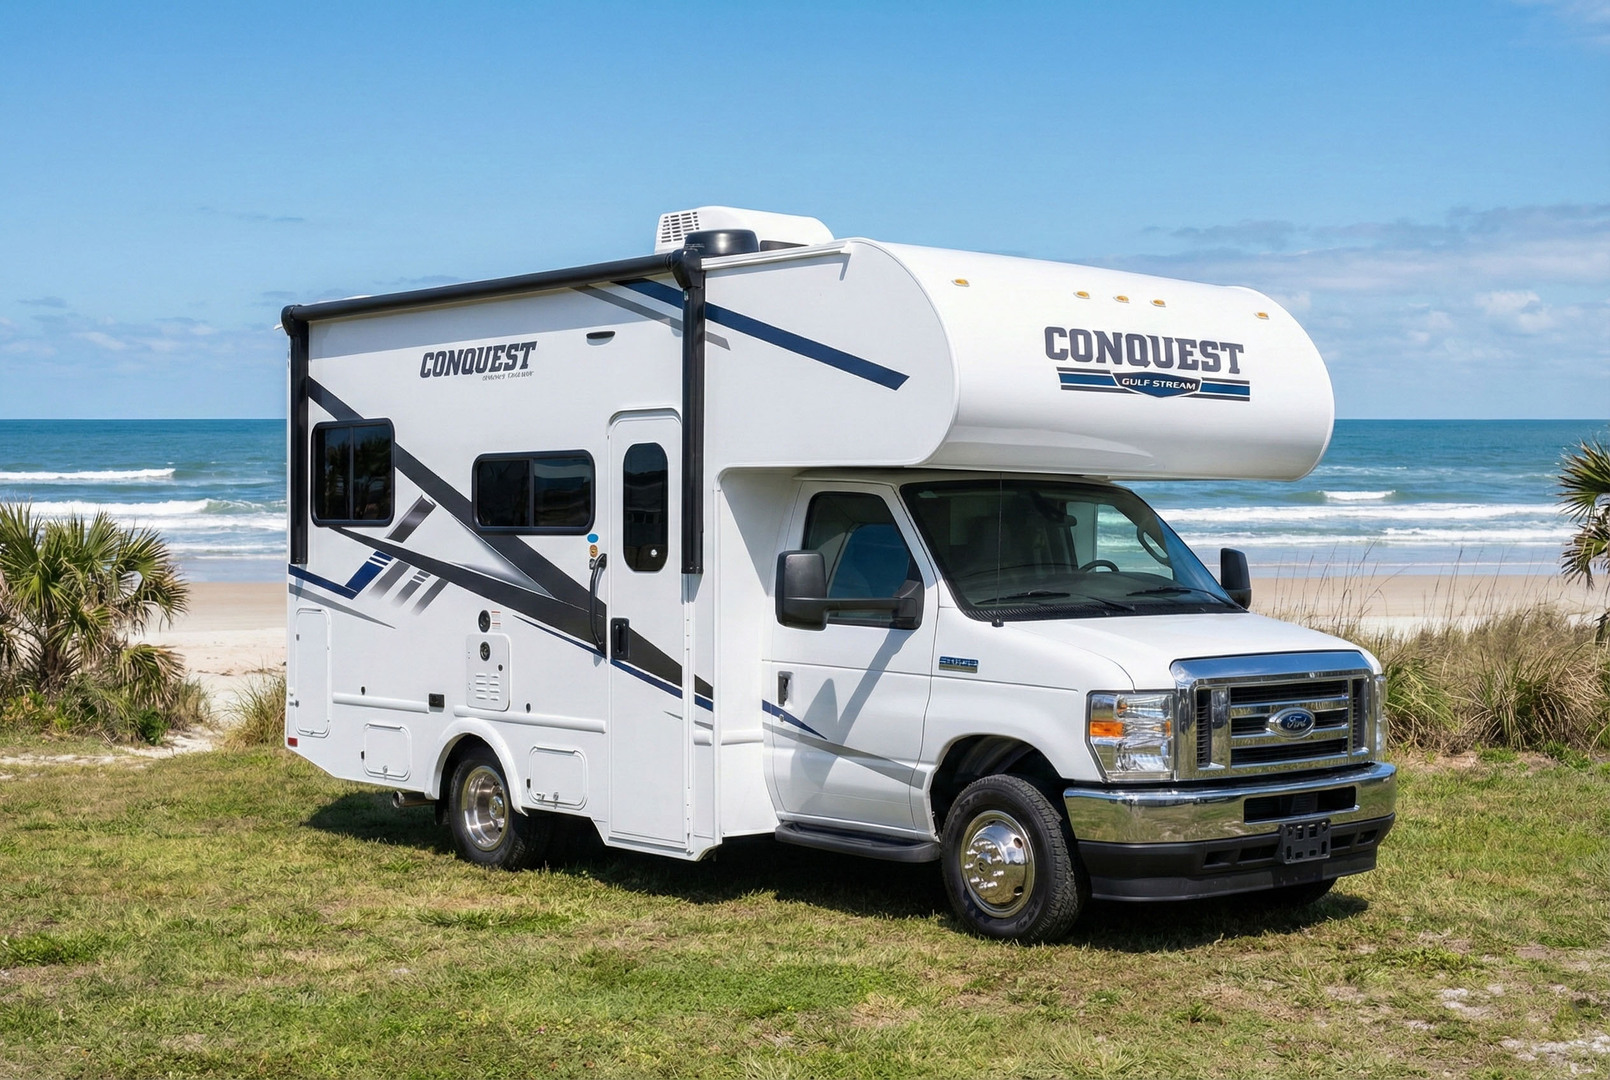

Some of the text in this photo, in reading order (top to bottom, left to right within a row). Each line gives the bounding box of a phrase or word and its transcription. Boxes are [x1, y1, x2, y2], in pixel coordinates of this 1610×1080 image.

[419, 340, 538, 379] CONQUEST
[1044, 326, 1245, 375] CONQUEST
[1121, 377, 1196, 390] GULF STREAM
